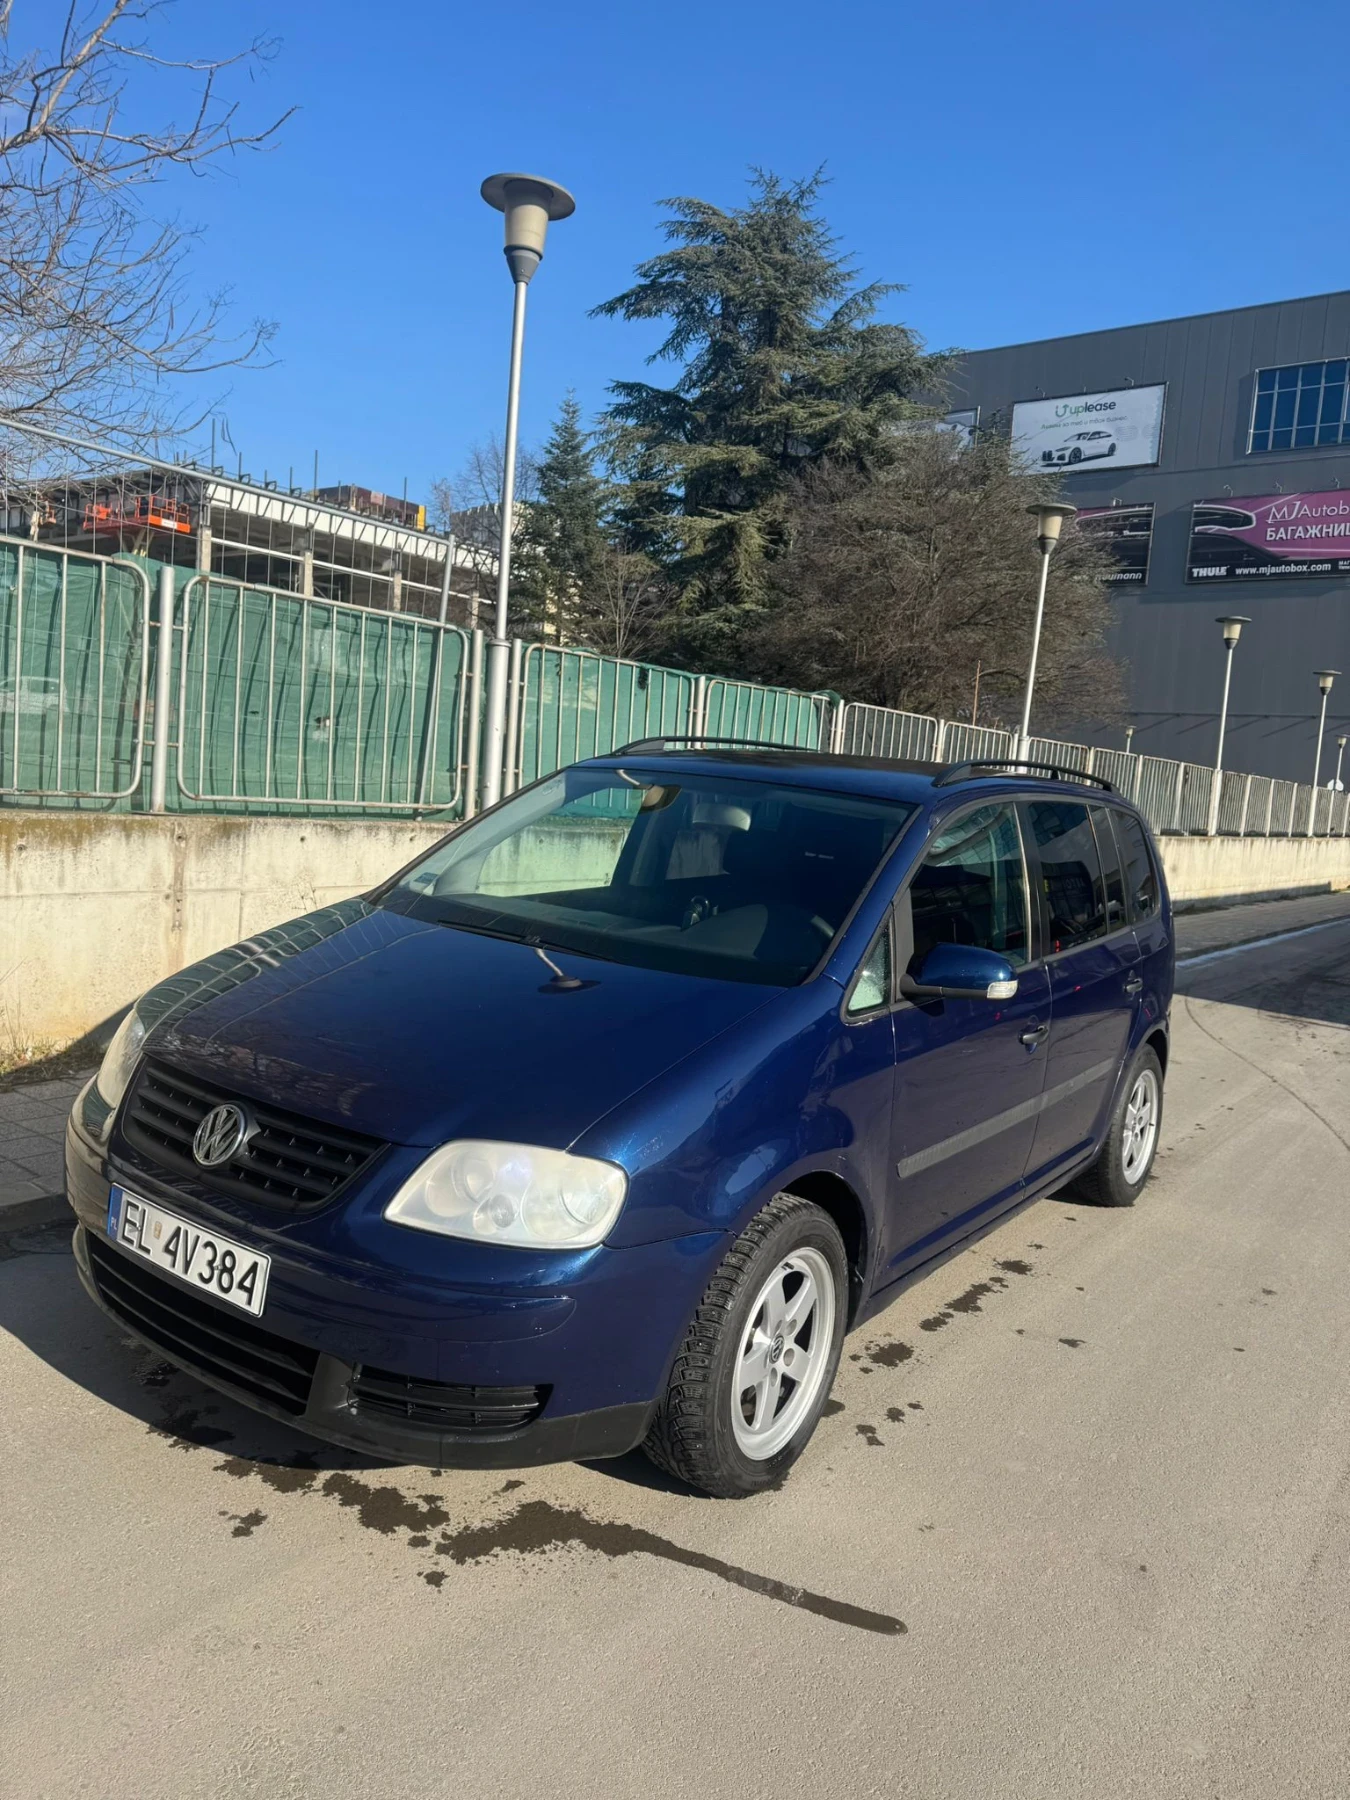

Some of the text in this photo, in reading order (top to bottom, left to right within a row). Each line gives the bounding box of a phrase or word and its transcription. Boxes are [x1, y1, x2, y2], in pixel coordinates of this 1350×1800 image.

[1070, 401, 1116, 416] uplease
[1192, 566, 1228, 577] THULE
[1235, 563, 1332, 577] www.mjautobox.com
[121, 1199, 259, 1306] EL 4V384
